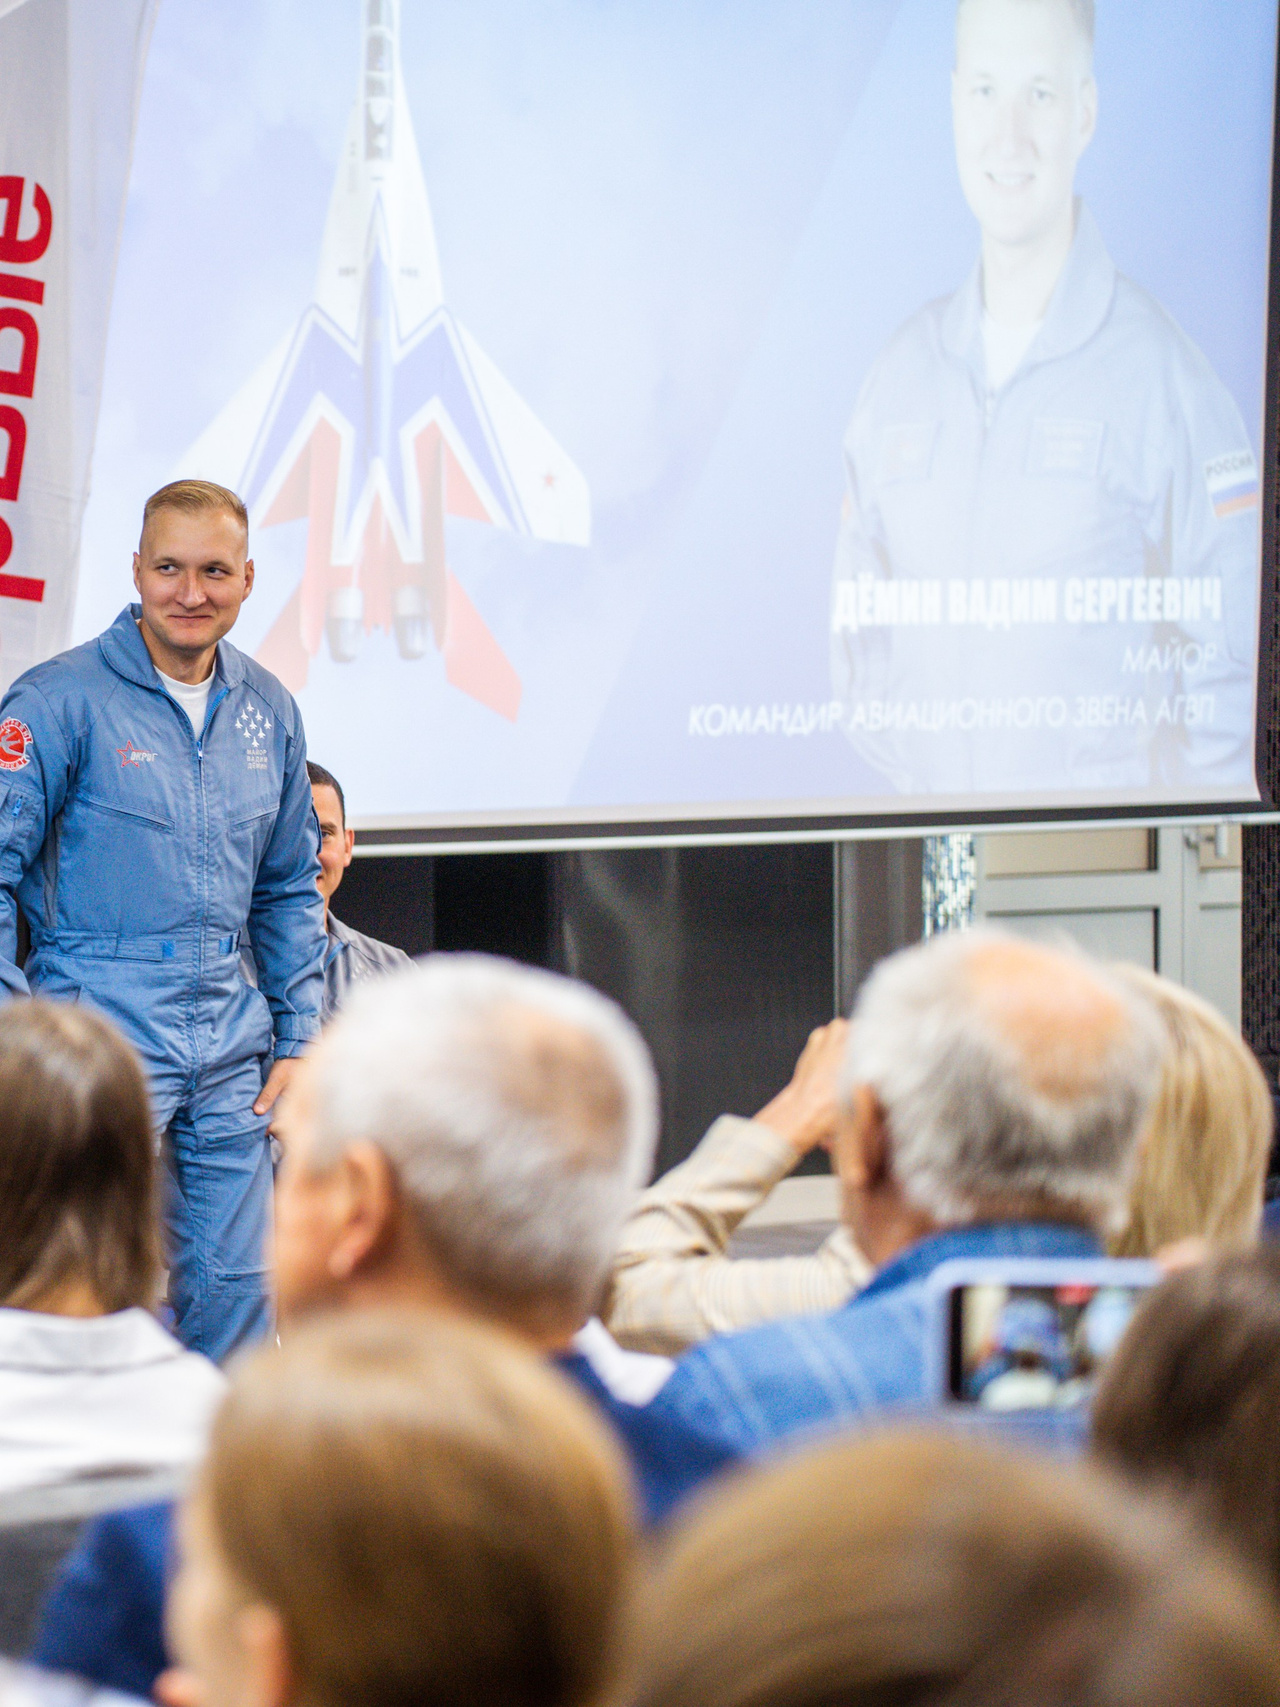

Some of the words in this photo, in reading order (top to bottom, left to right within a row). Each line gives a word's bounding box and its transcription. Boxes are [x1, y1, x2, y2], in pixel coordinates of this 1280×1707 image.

[833, 573, 941, 632] ДЁМИН
[947, 578, 1057, 630] ВАДИМ
[1064, 576, 1222, 623] СЕРГЕЕВИЧ
[1120, 638, 1218, 673] МАЙОР
[687, 700, 842, 737] КОМАНДИР
[849, 695, 1067, 734] АВИАЦИОННОГО
[1073, 694, 1147, 728] ЗВЕНА
